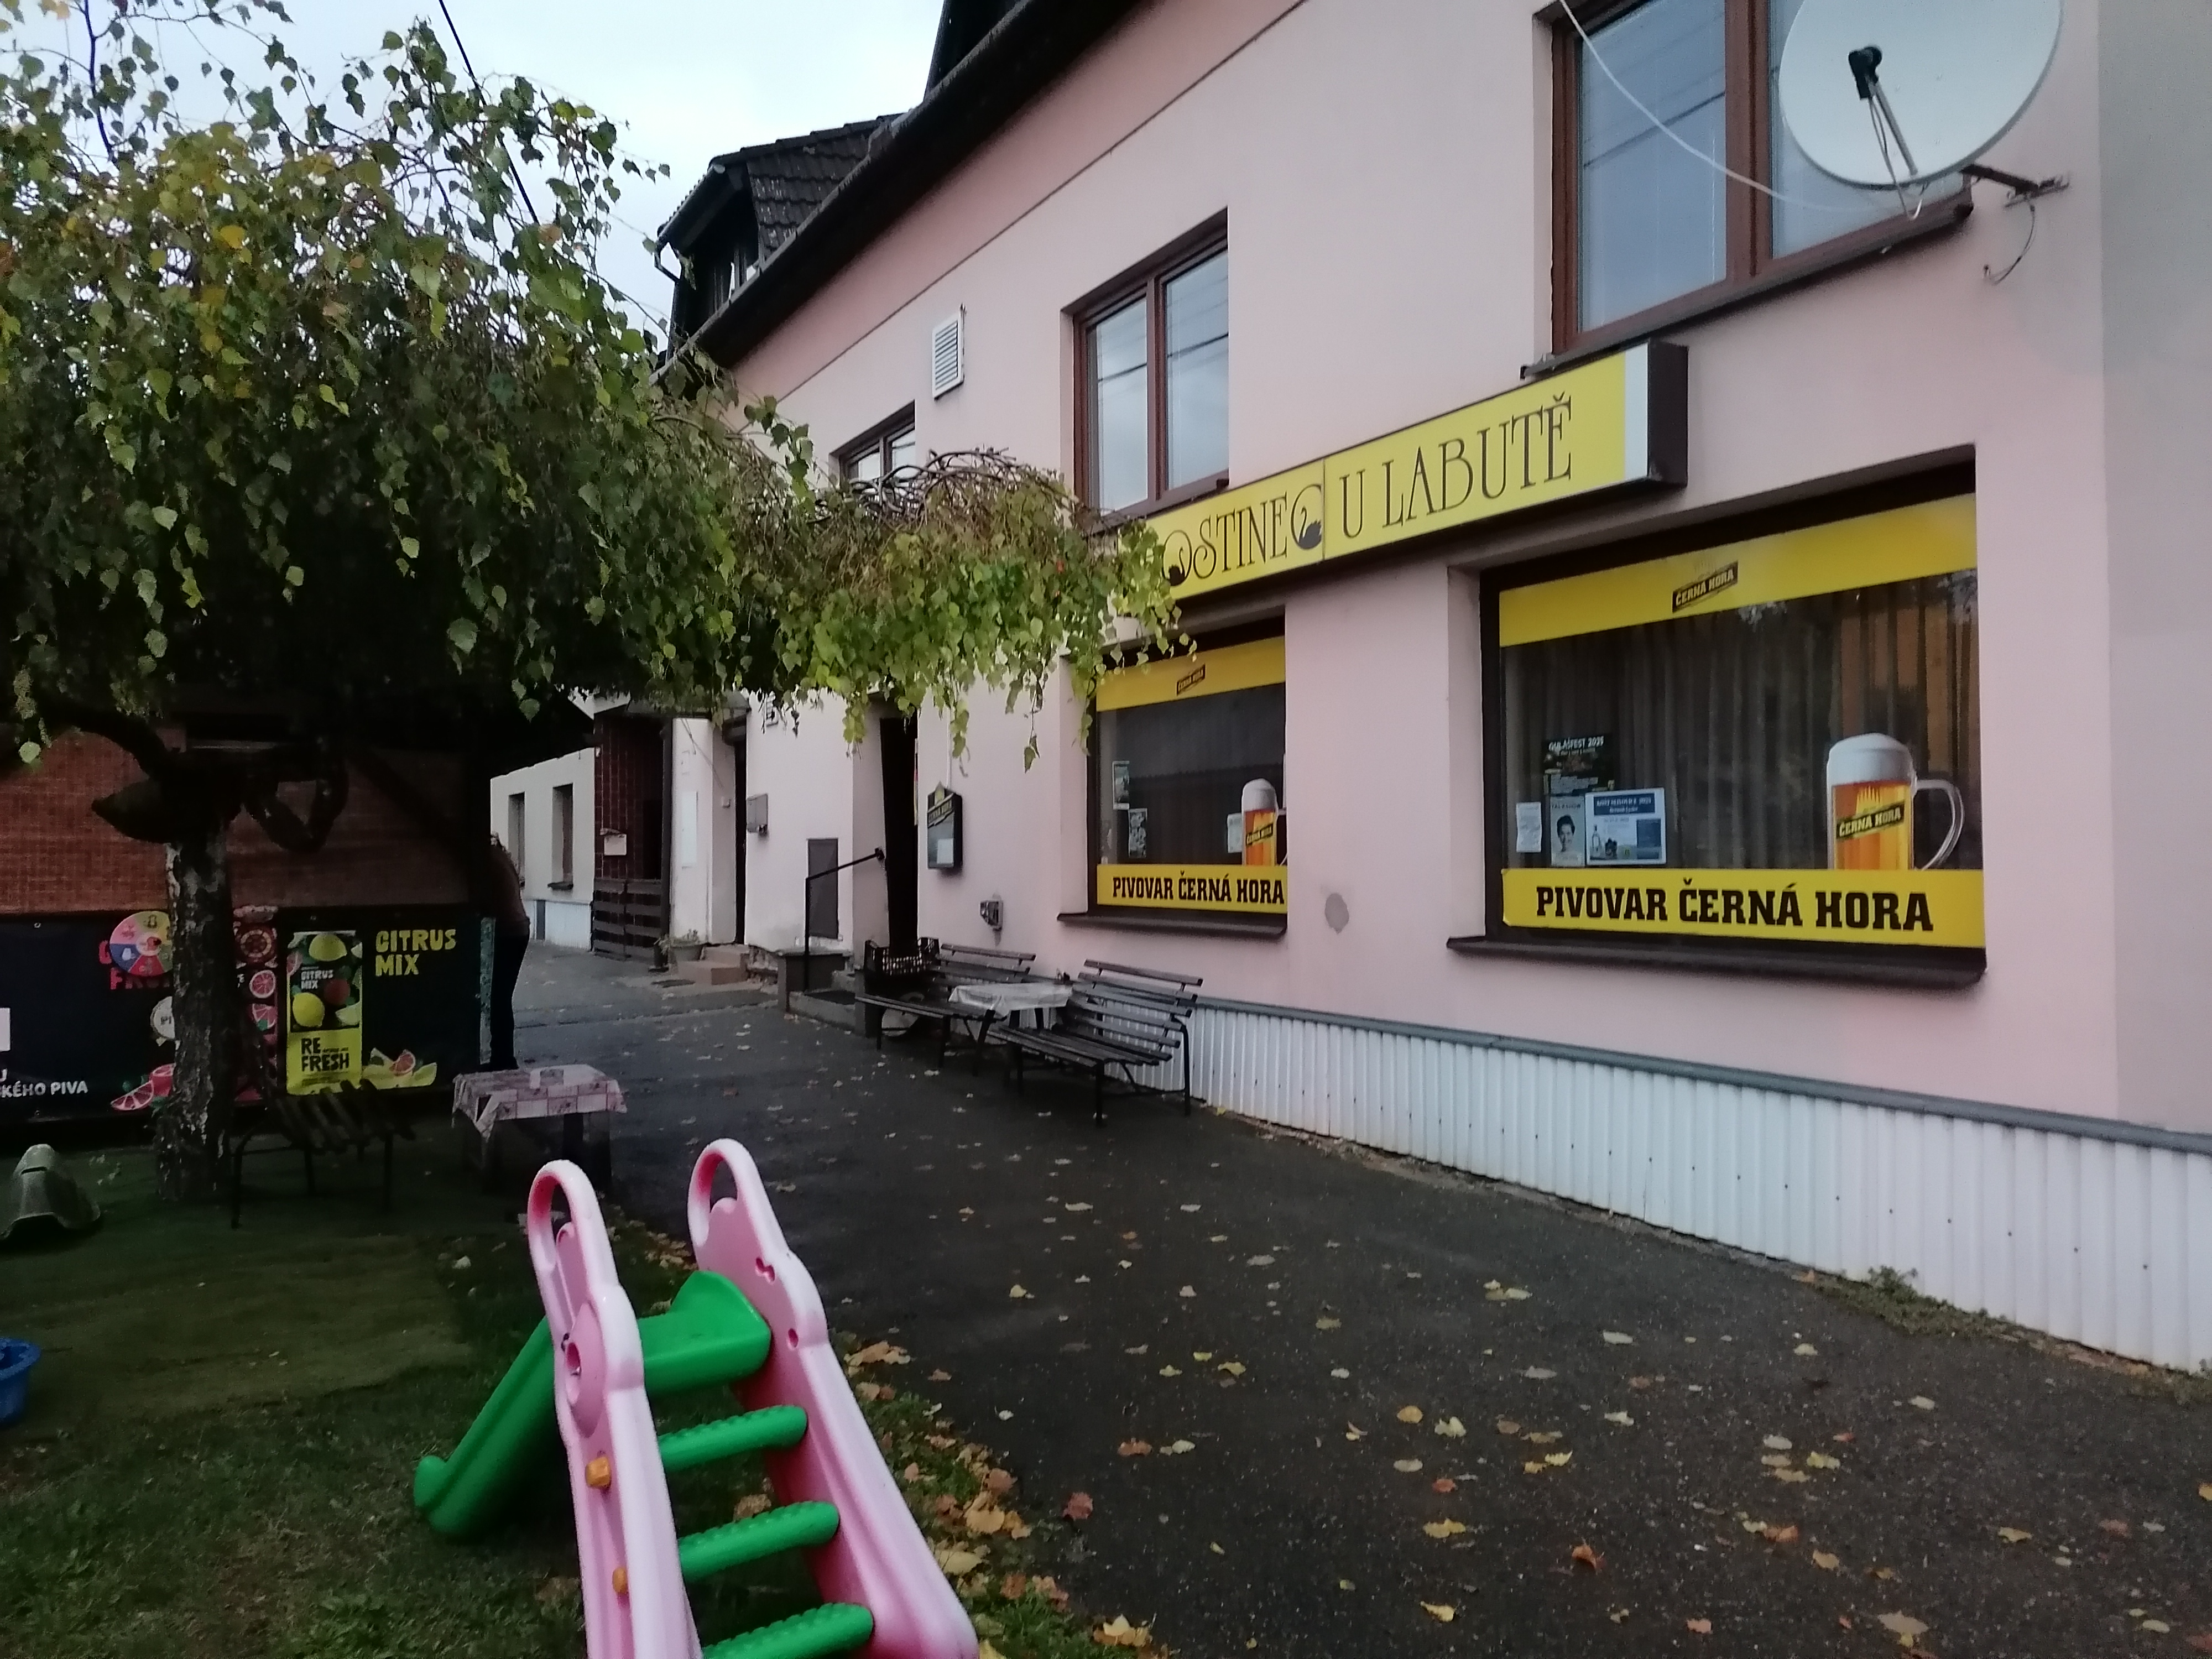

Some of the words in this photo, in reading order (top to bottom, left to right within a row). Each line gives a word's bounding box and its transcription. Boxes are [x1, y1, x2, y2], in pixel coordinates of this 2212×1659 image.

[1162, 483, 1323, 587] OSTINEC
[1339, 469, 1366, 538] U
[1383, 391, 1572, 527] LABUTĚ
[1709, 568, 1734, 591] HORA
[1875, 807, 1901, 827] HORA
[1113, 877, 1173, 900] PIVOVAR
[1178, 870, 1232, 902] ČERNÁ
[1237, 879, 1285, 904] HORA
[1536, 886, 1668, 921] PIVOVAR
[1679, 878, 1803, 926] ČERNÁ
[1815, 891, 1934, 931] HORA
[375, 928, 457, 953] CITRUS
[301, 969, 333, 980] CITRUS
[375, 953, 420, 977] MIX
[301, 980, 319, 989] MIX
[301, 1037, 321, 1054] RE
[301, 1053, 349, 1072] FRESH
[0, 1080, 46, 1098] KÉHO
[50, 1080, 88, 1097] PIVA
